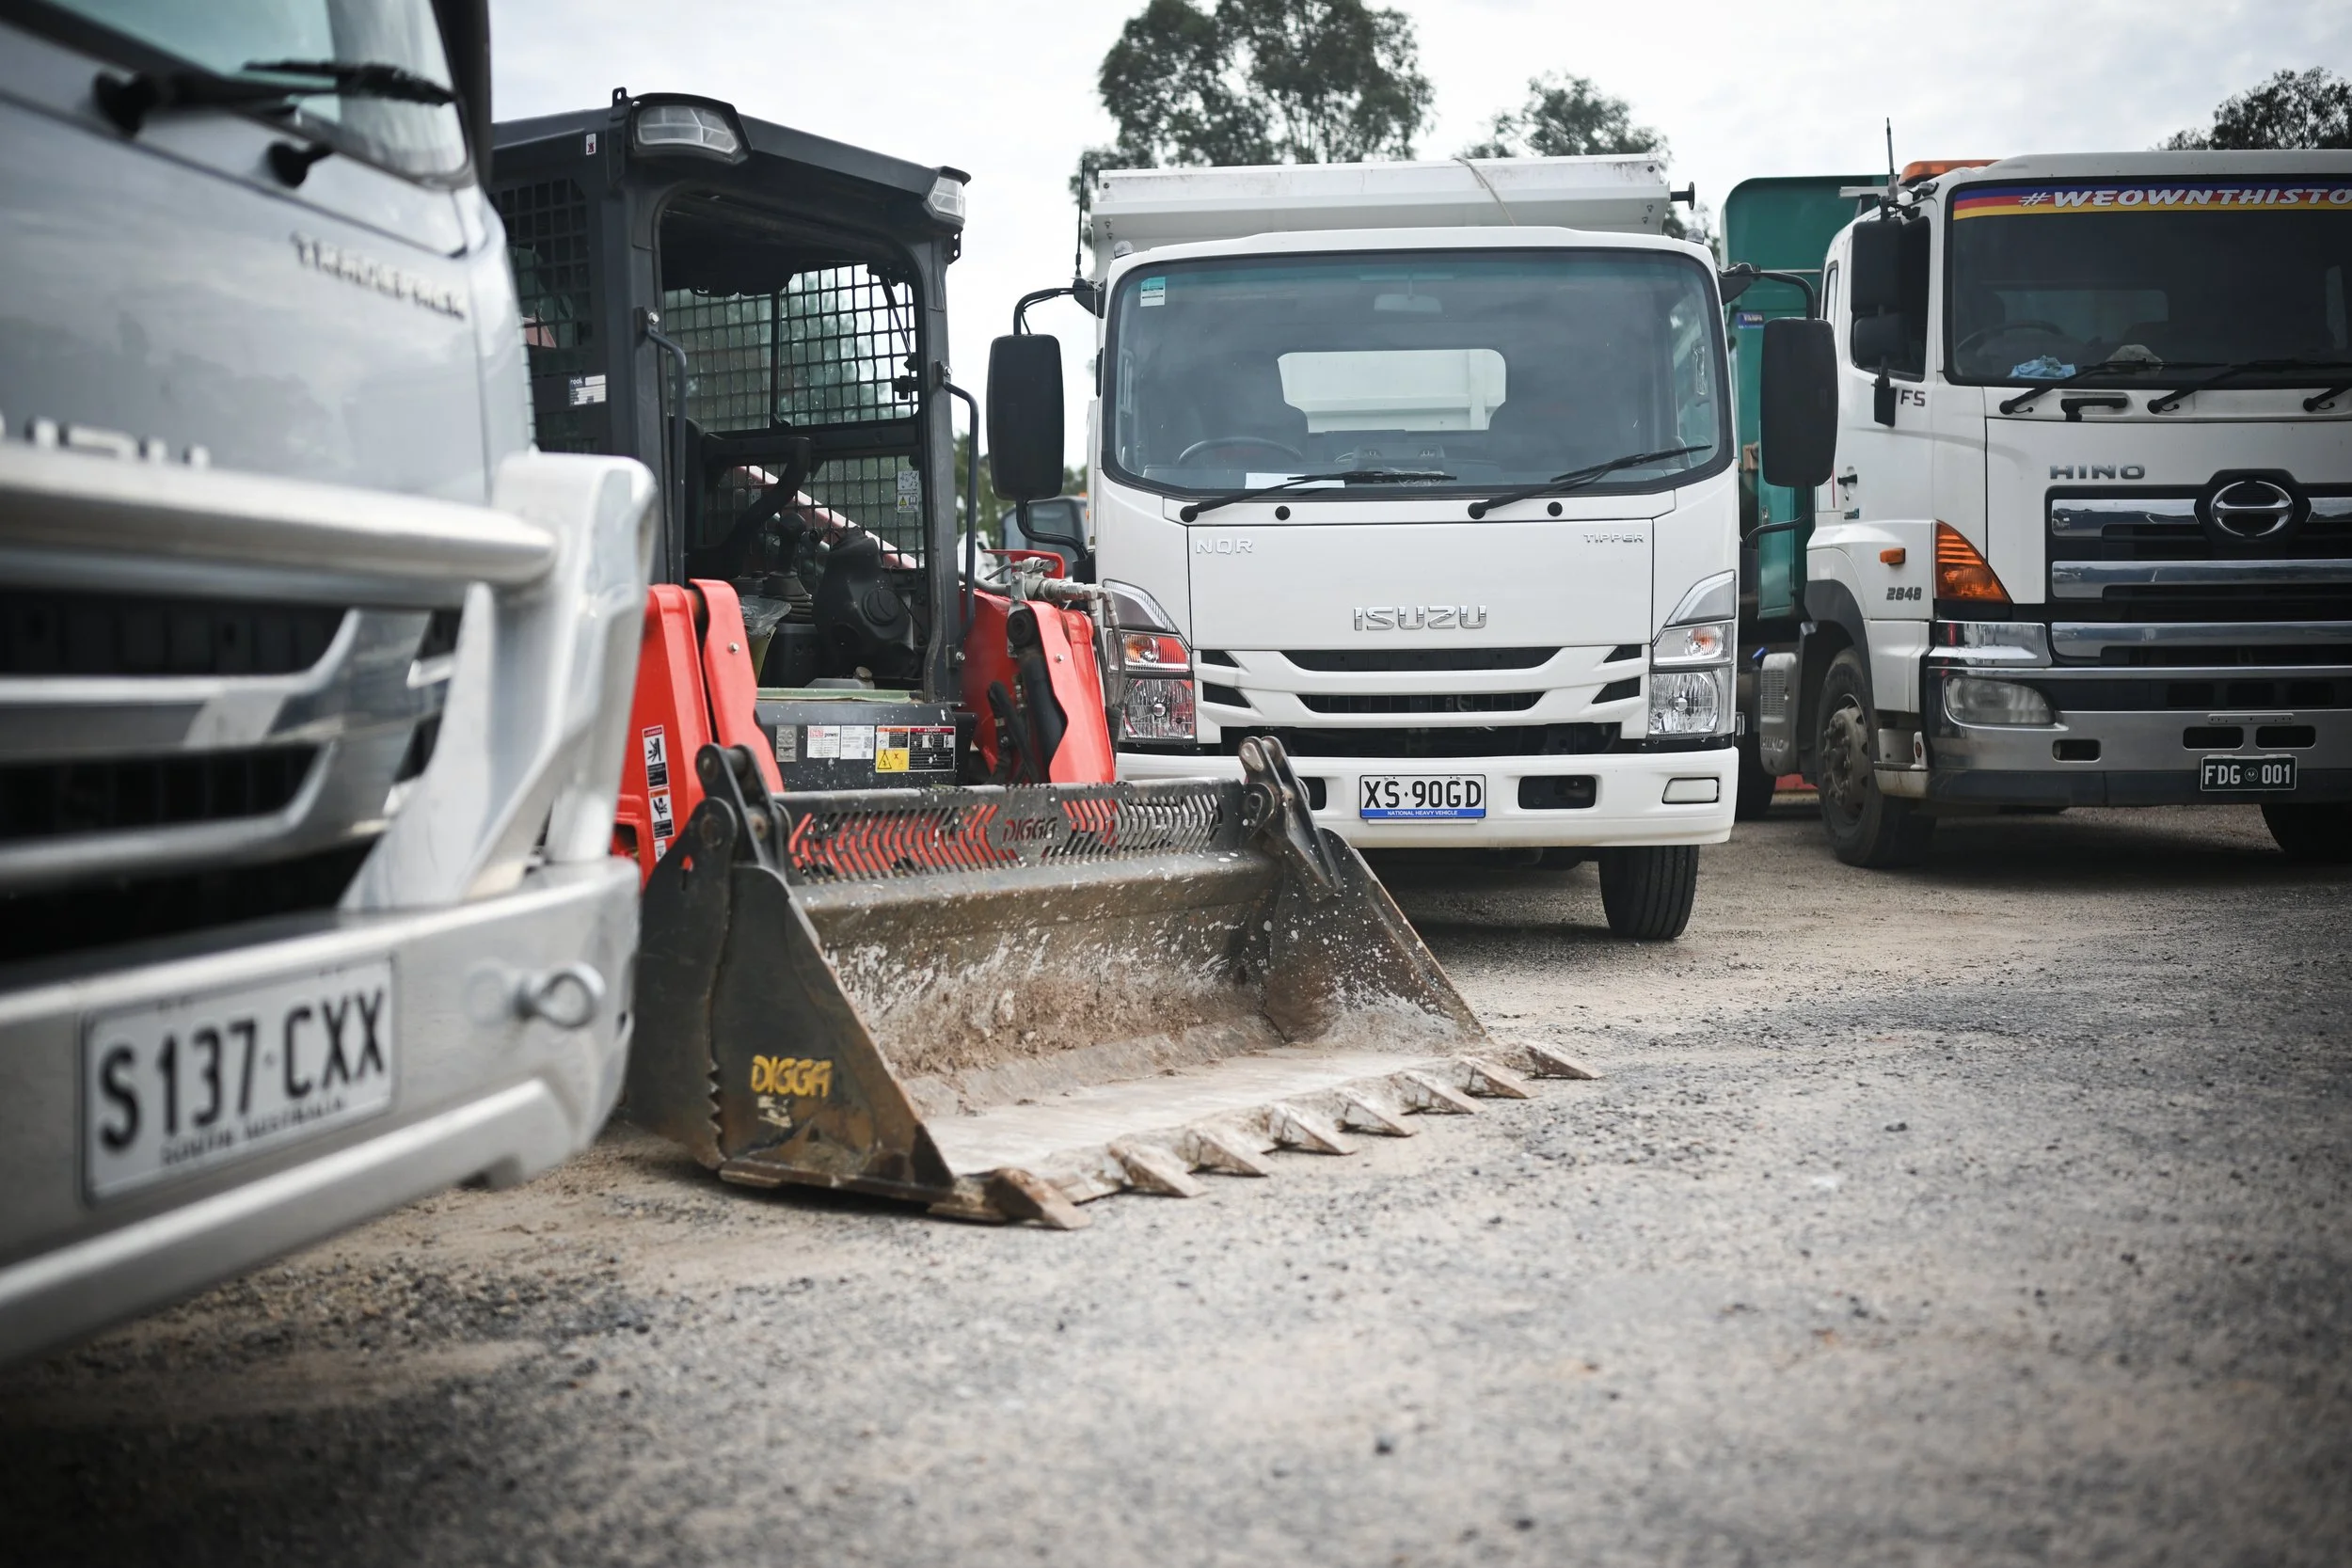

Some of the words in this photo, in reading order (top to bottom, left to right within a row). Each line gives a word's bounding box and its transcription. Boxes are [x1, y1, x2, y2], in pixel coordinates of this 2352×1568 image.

[1900, 389, 1926, 407] FS
[2050, 465, 2145, 480] HINO
[1196, 538, 1253, 555] NQR
[1583, 532, 1645, 544] TIPPER
[1886, 587, 1922, 601] 2848
[1354, 605, 1486, 631] ISUZU
[2204, 765, 2241, 785] FDG
[2262, 764, 2291, 784] 001
[1003, 816, 1057, 843] DIGGA
[752, 1054, 833, 1099] DIGGA
